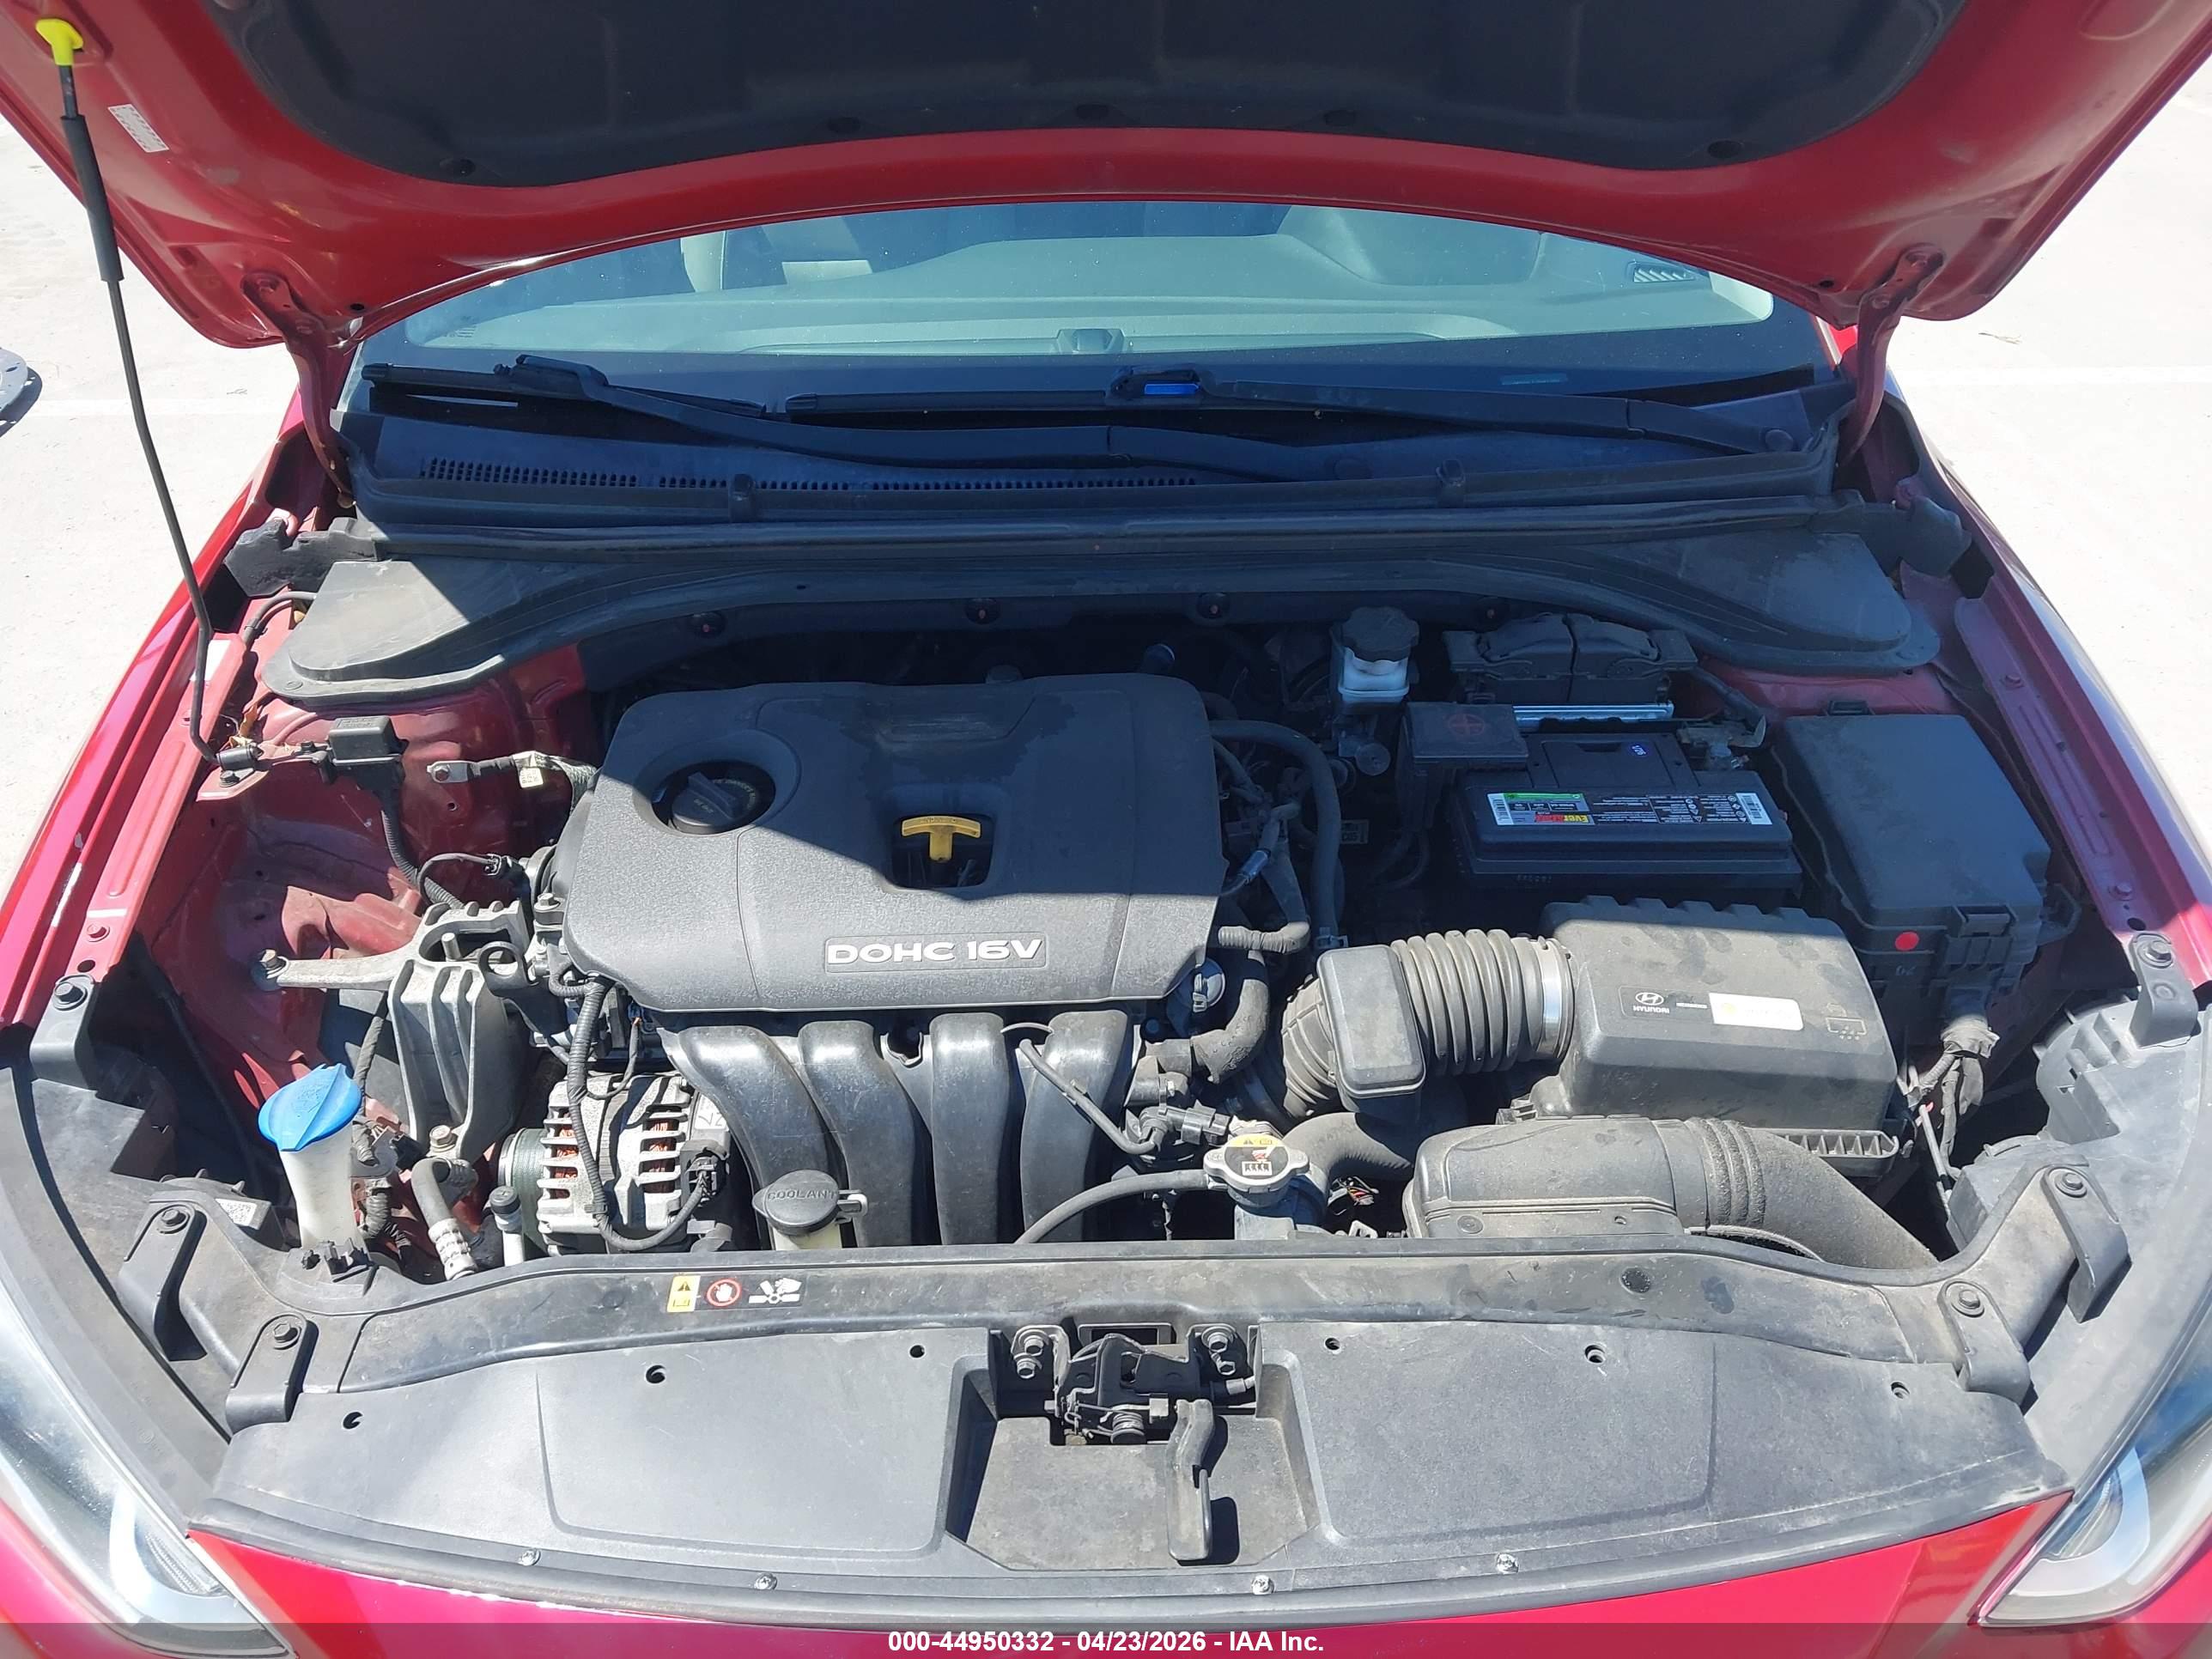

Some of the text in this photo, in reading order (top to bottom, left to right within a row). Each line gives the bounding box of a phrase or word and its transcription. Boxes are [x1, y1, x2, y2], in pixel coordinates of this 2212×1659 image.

[827, 939, 1043, 965] DOHC 16V
[1632, 1005, 1670, 1014] HYUNDAI
[767, 1188, 838, 1201] COOLANT
